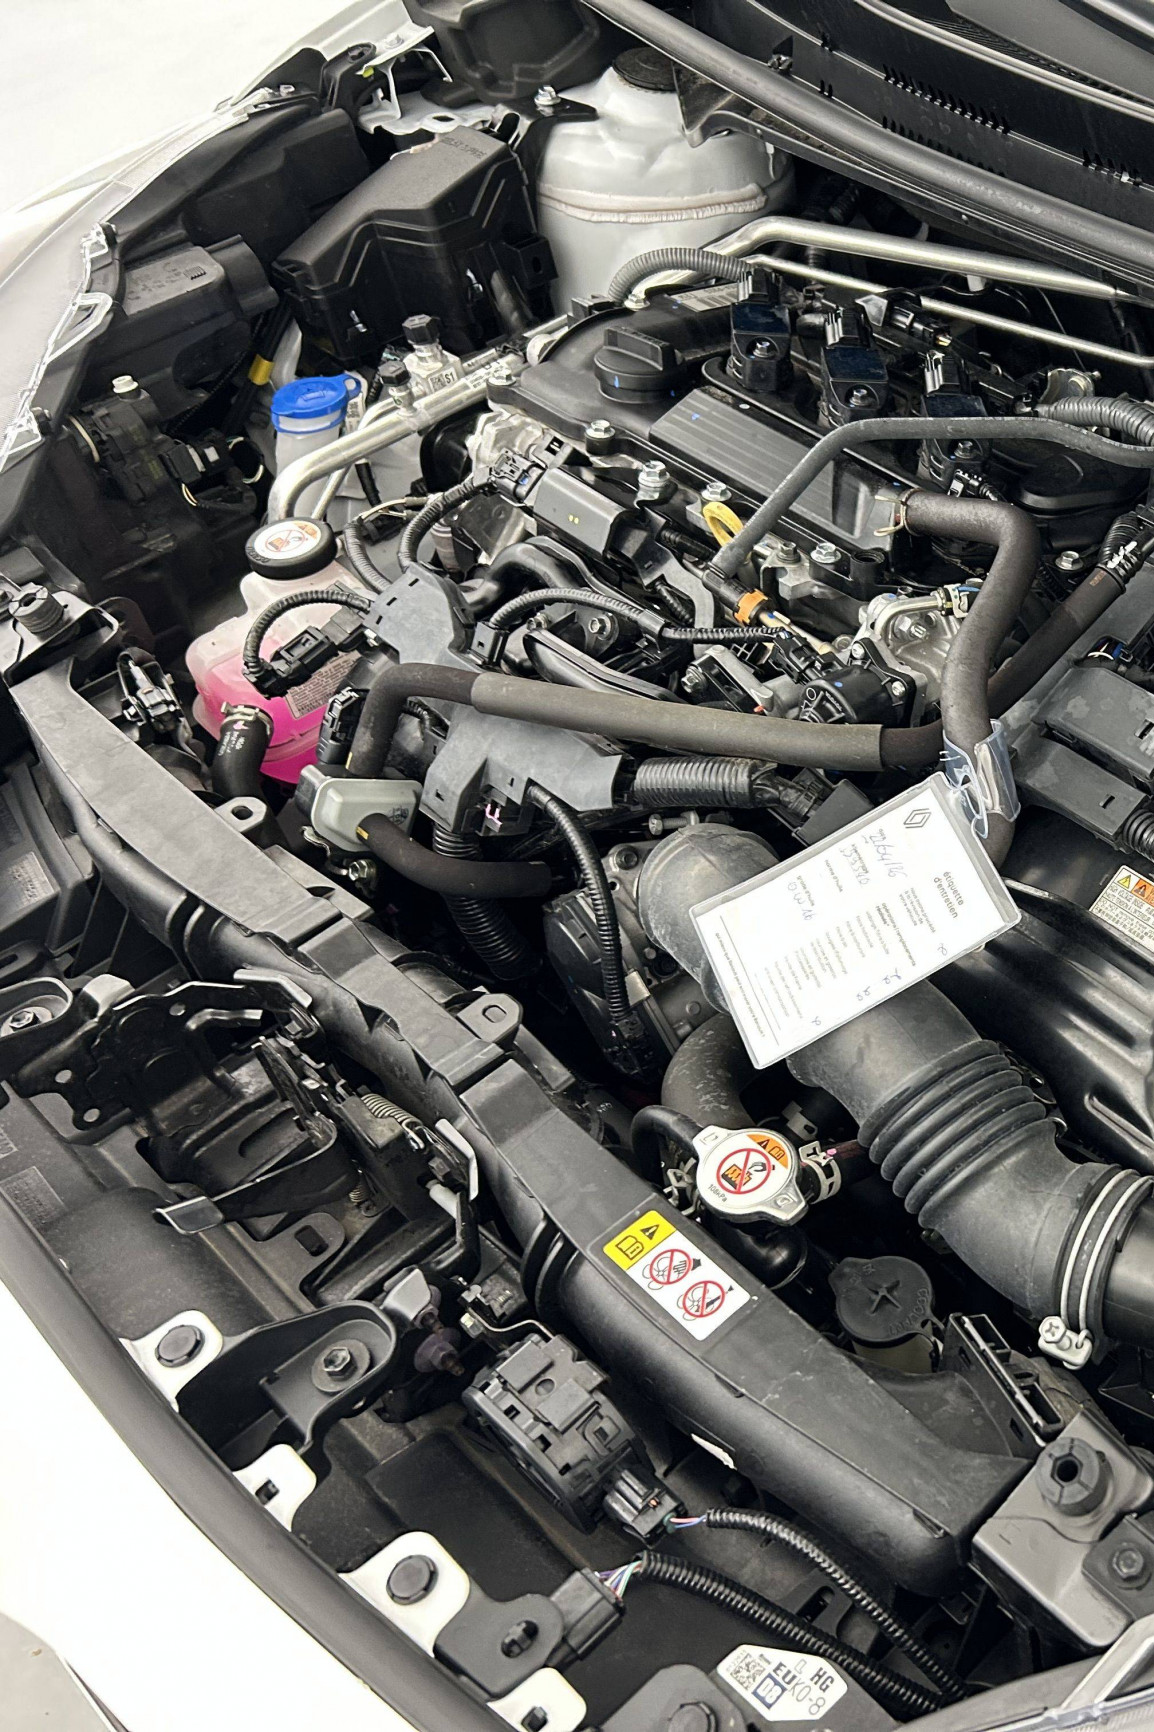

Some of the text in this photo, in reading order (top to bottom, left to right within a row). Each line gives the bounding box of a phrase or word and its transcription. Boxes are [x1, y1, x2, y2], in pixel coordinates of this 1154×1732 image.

[443, 370, 456, 384] S1
[933, 877, 958, 918] d'entretien
[943, 871, 964, 906] étiquette
[707, 1183, 728, 1202] 108kPa
[772, 1661, 797, 1685] EU
[810, 1667, 835, 1693] HG
